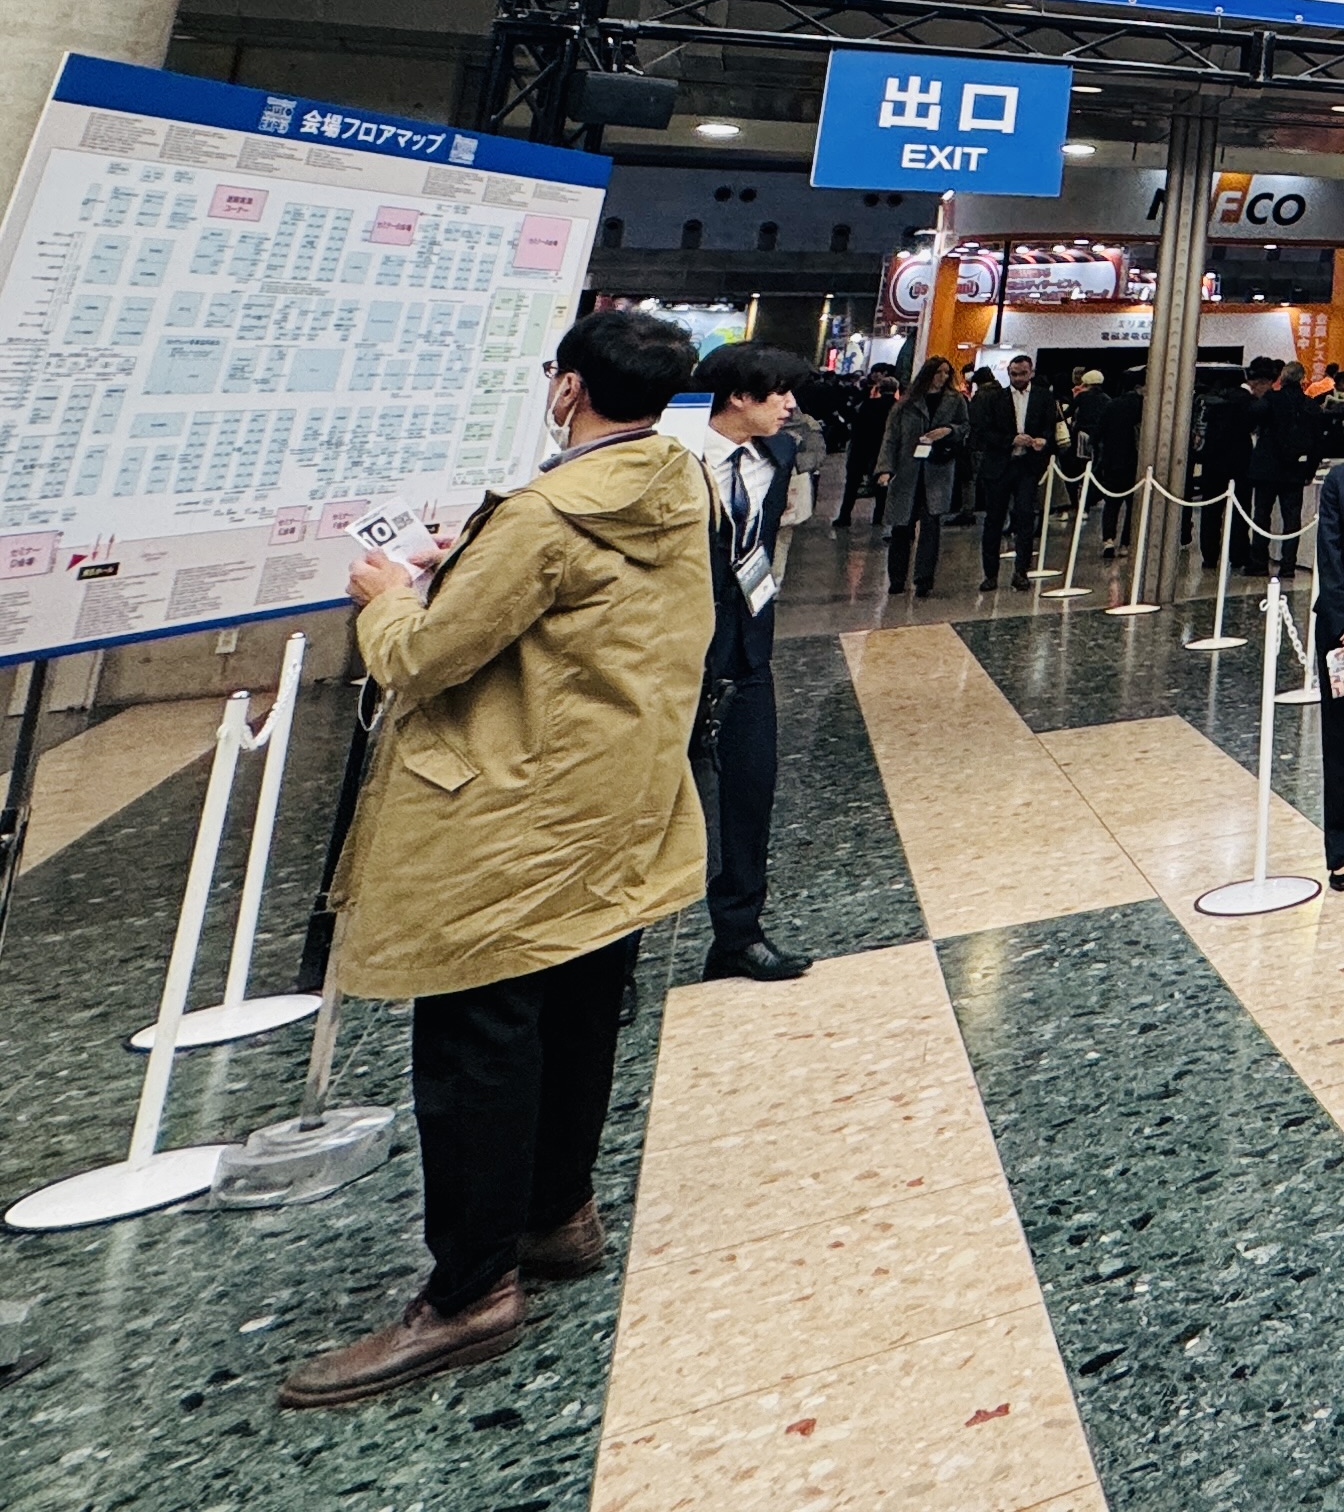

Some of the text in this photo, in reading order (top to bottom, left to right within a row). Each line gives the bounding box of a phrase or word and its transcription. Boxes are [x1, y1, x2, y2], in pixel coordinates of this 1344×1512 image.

[878, 75, 1019, 134] 出口
[300, 109, 447, 154] 会場フロアマップ
[901, 143, 988, 172] EXIT
